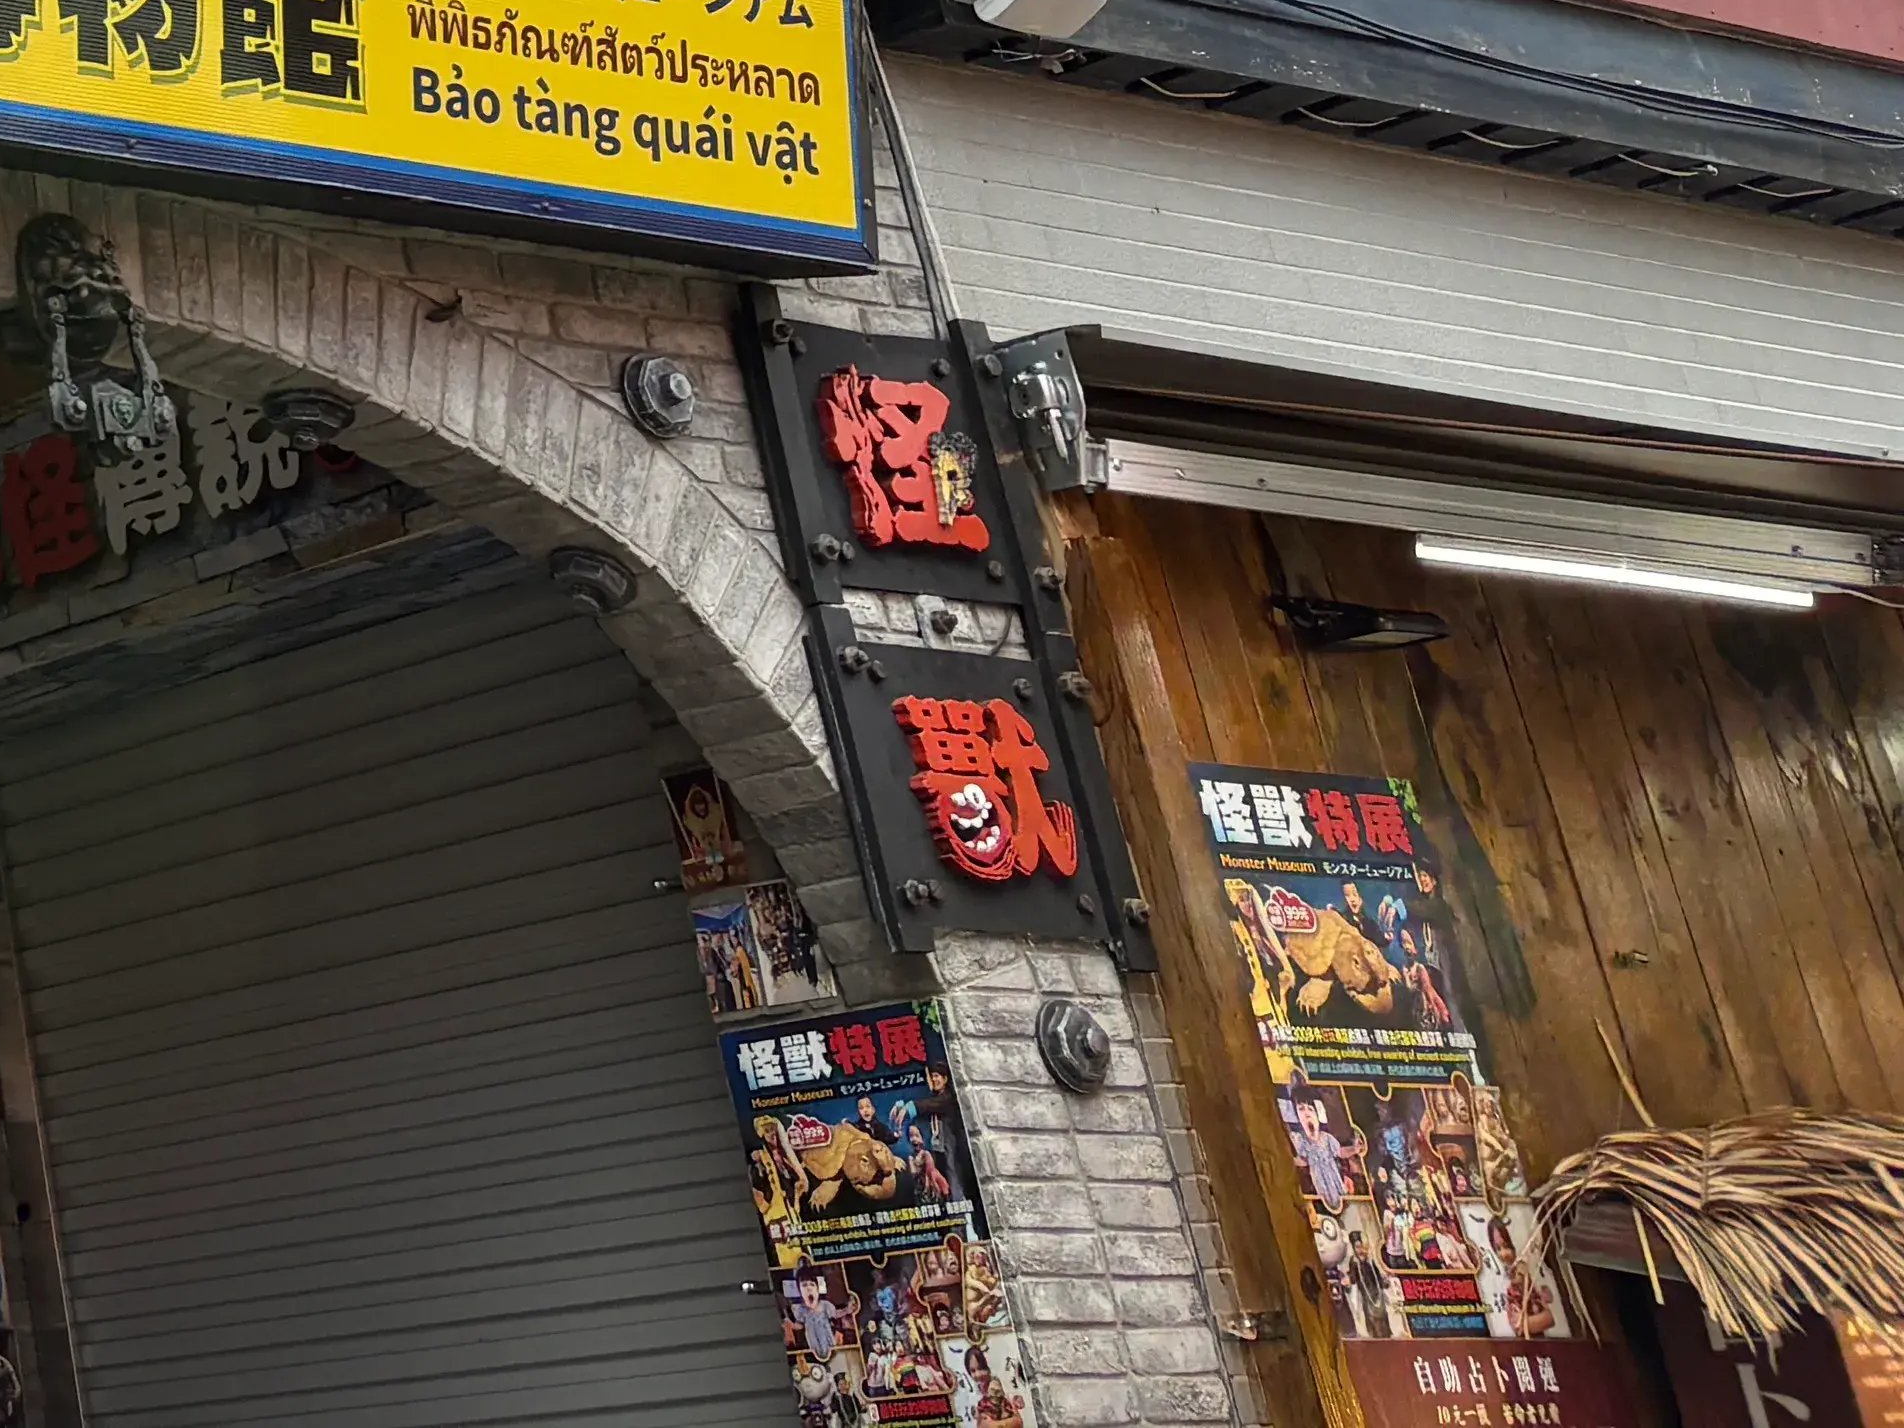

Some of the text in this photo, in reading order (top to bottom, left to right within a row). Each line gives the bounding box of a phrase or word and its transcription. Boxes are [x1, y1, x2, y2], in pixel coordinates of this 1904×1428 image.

[412, 64, 820, 186] Bảo tàng quái vật
[1199, 779, 1413, 856] 怪獸特展
[1220, 853, 1317, 874] Monster Museum
[738, 1016, 928, 1091] 怪獸特展
